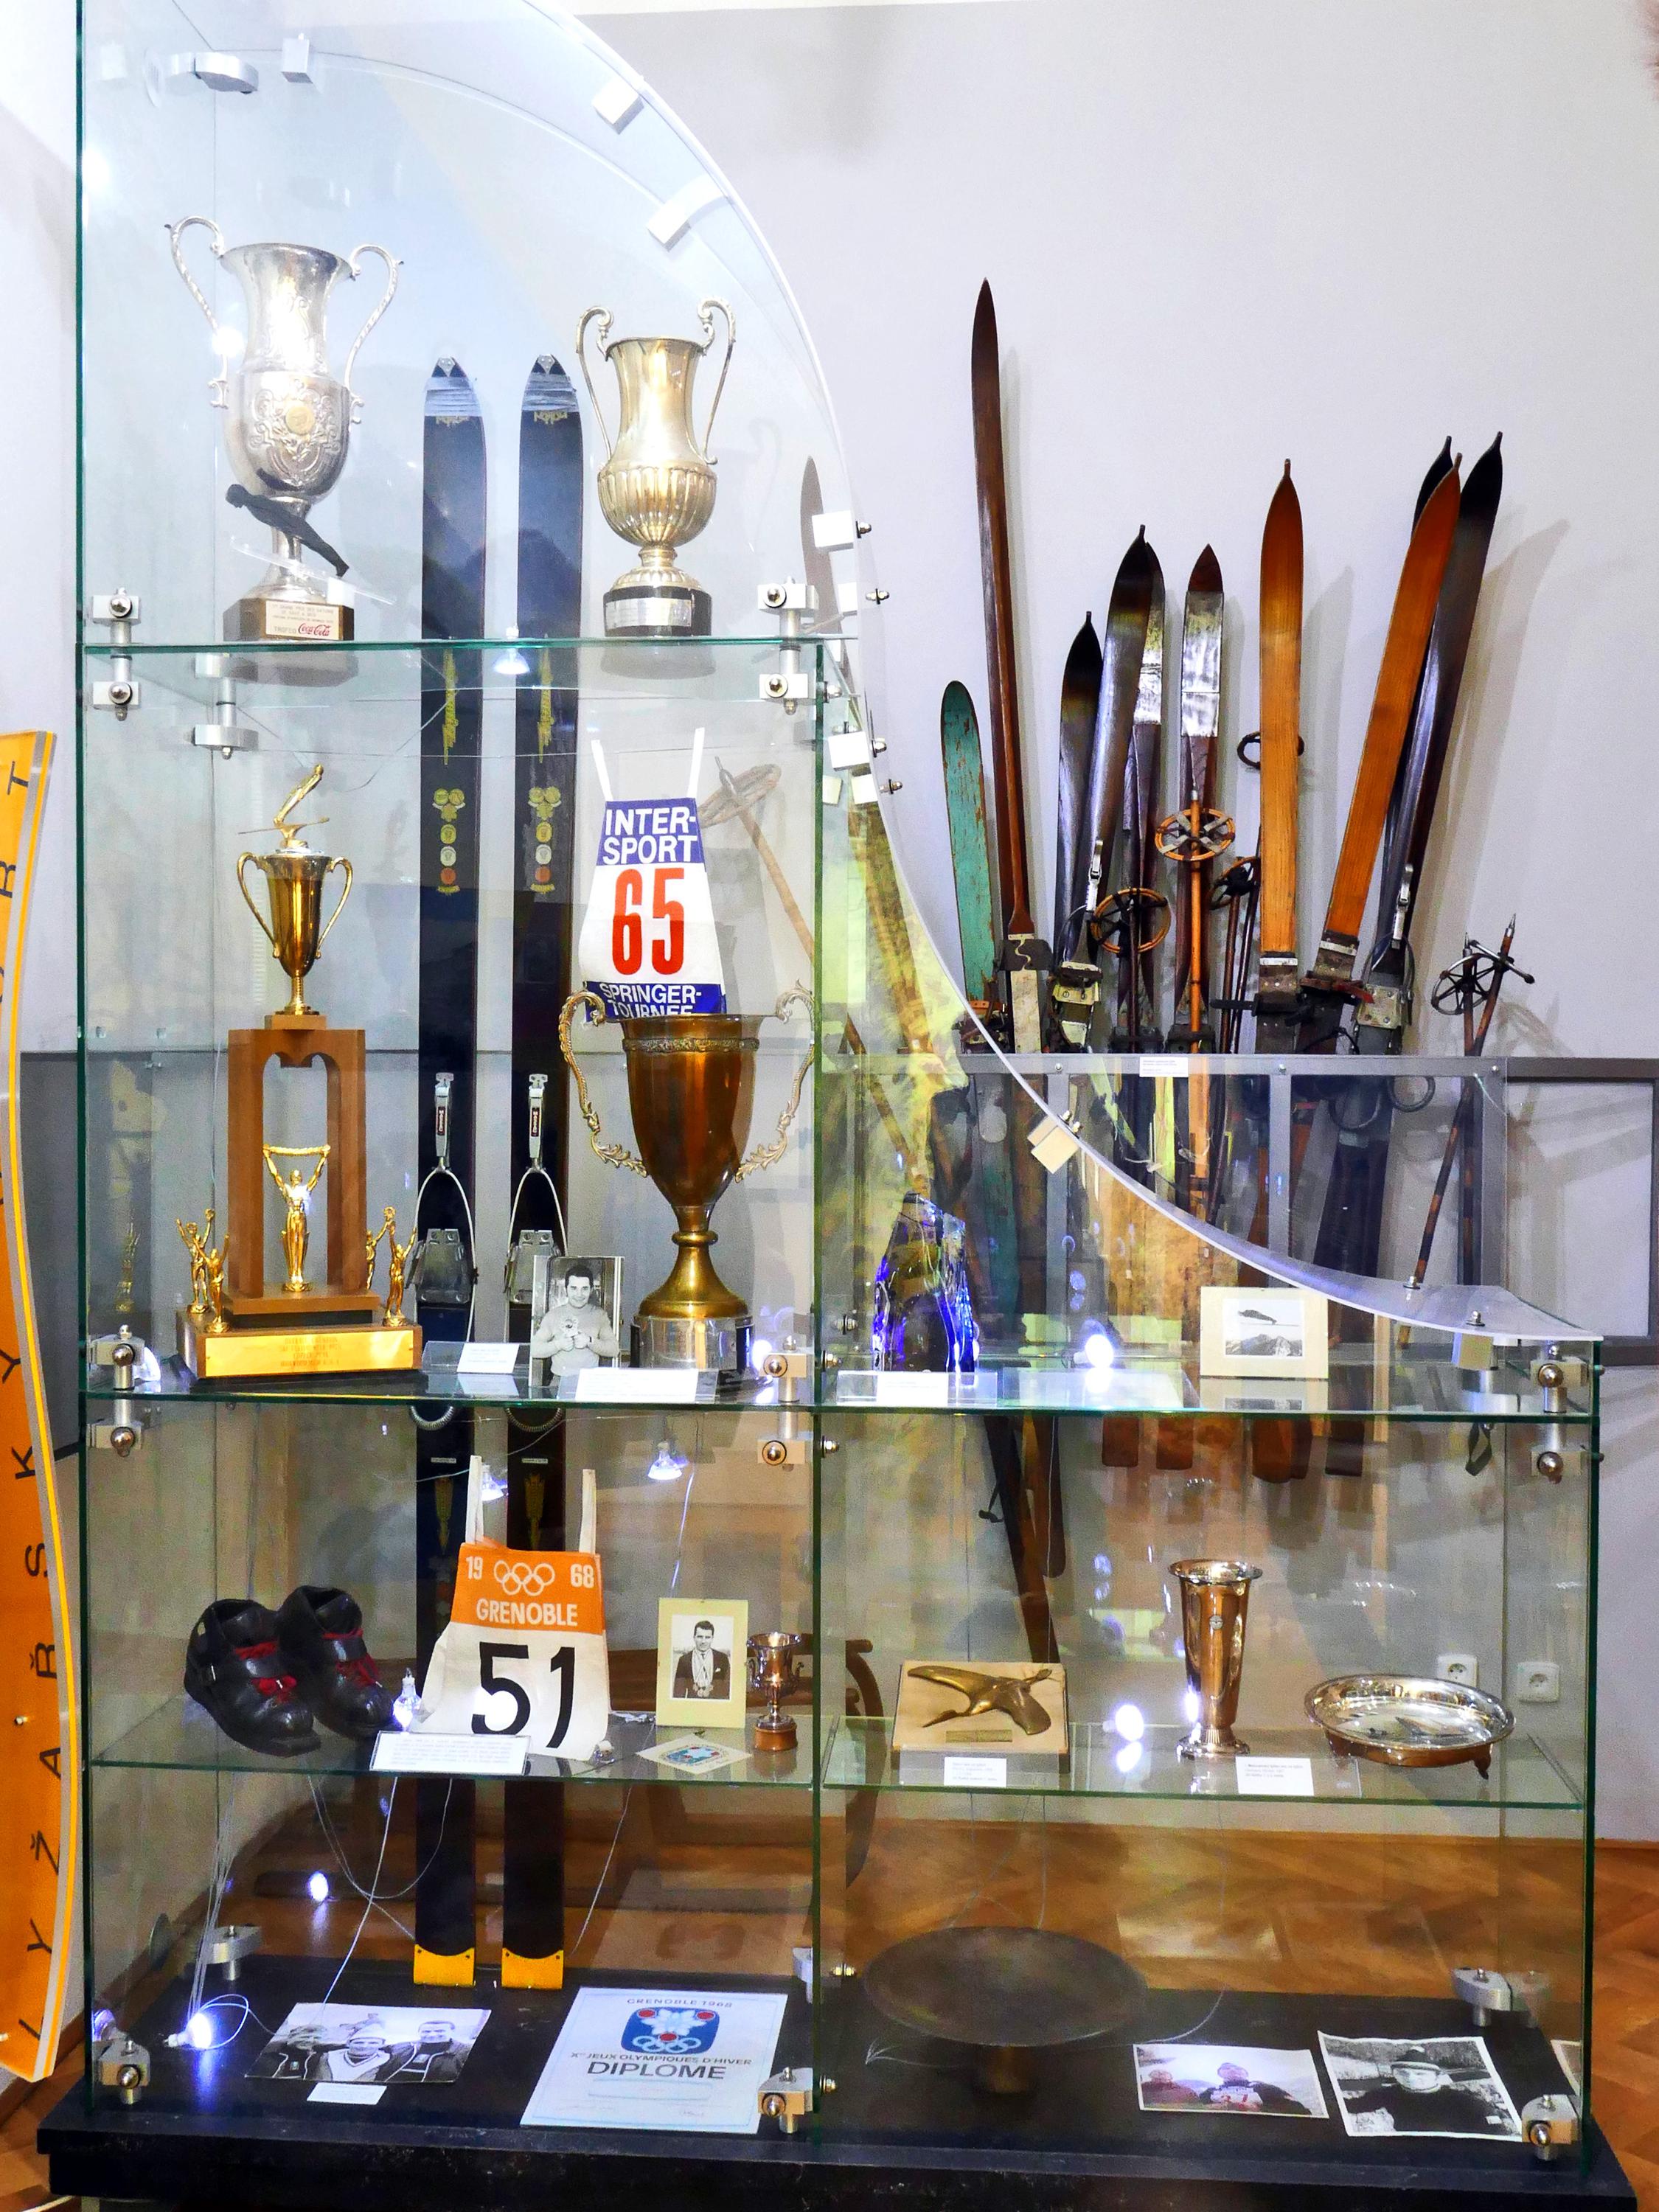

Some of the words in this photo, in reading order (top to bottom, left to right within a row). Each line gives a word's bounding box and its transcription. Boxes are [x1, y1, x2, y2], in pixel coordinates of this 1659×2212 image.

[605, 807, 696, 836] INTER-
[602, 835, 698, 865] SPORT
[612, 867, 684, 975] 65
[599, 983, 702, 1004] SPRINGER-
[465, 1556, 483, 1579] 19
[570, 1563, 594, 1588] 68
[476, 1598, 577, 1627] GRENOBLE
[471, 1641, 575, 1748] 51
[588, 2062, 726, 2079] DIPLOME
[619, 2054, 699, 2062] OLYMPIQUES
